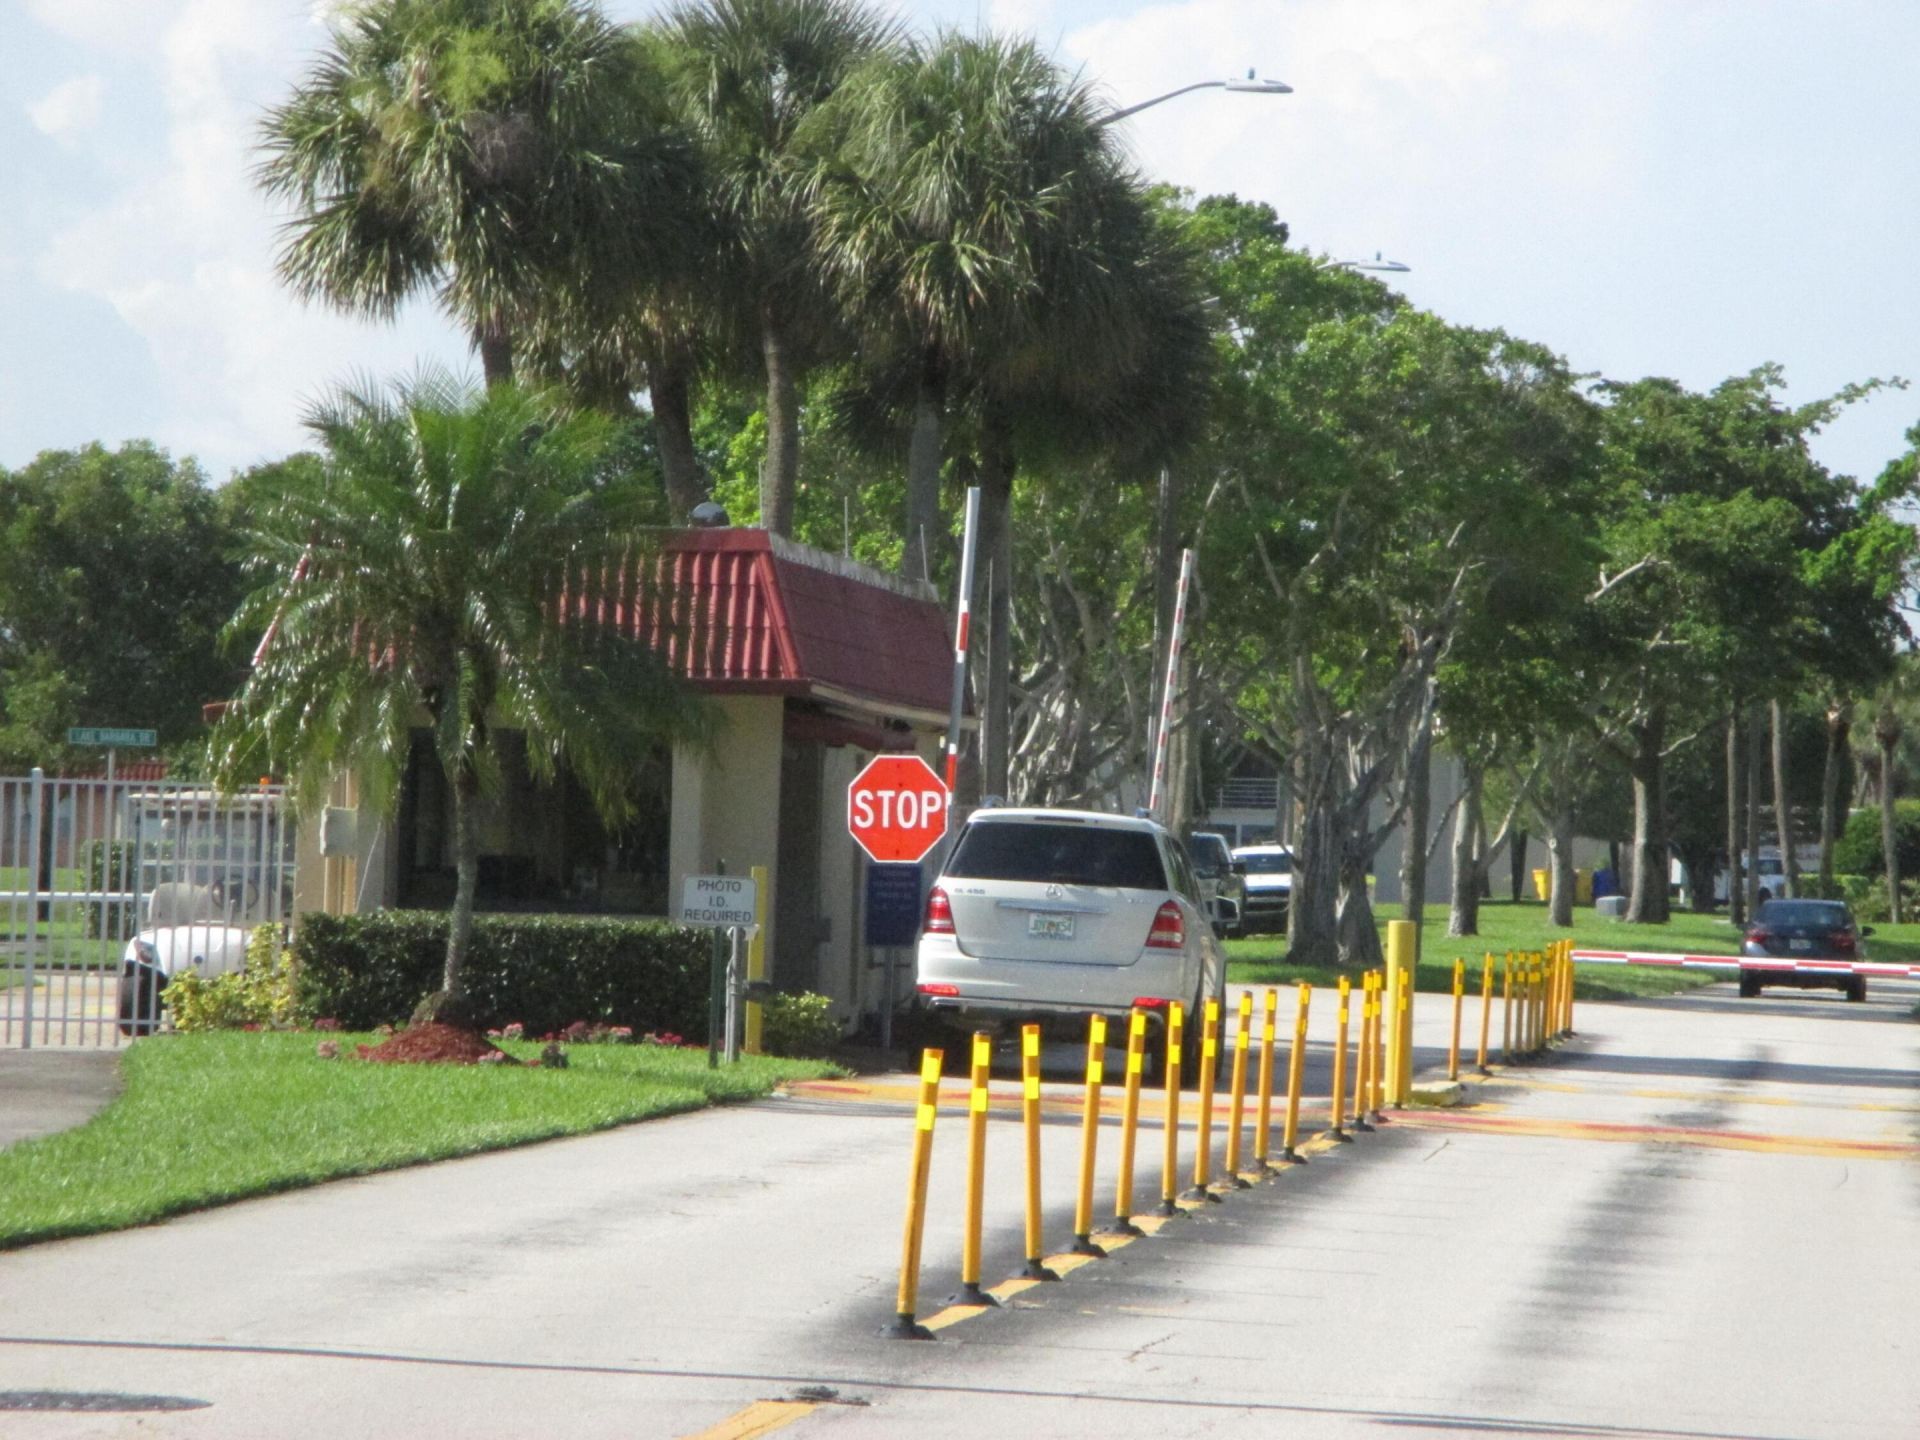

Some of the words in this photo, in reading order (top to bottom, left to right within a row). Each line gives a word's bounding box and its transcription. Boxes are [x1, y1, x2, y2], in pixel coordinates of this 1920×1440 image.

[854, 789, 942, 829] STOP
[697, 879, 742, 893] PHOTO
[708, 895, 729, 908] I.D.
[683, 909, 753, 923] REQUIRED
